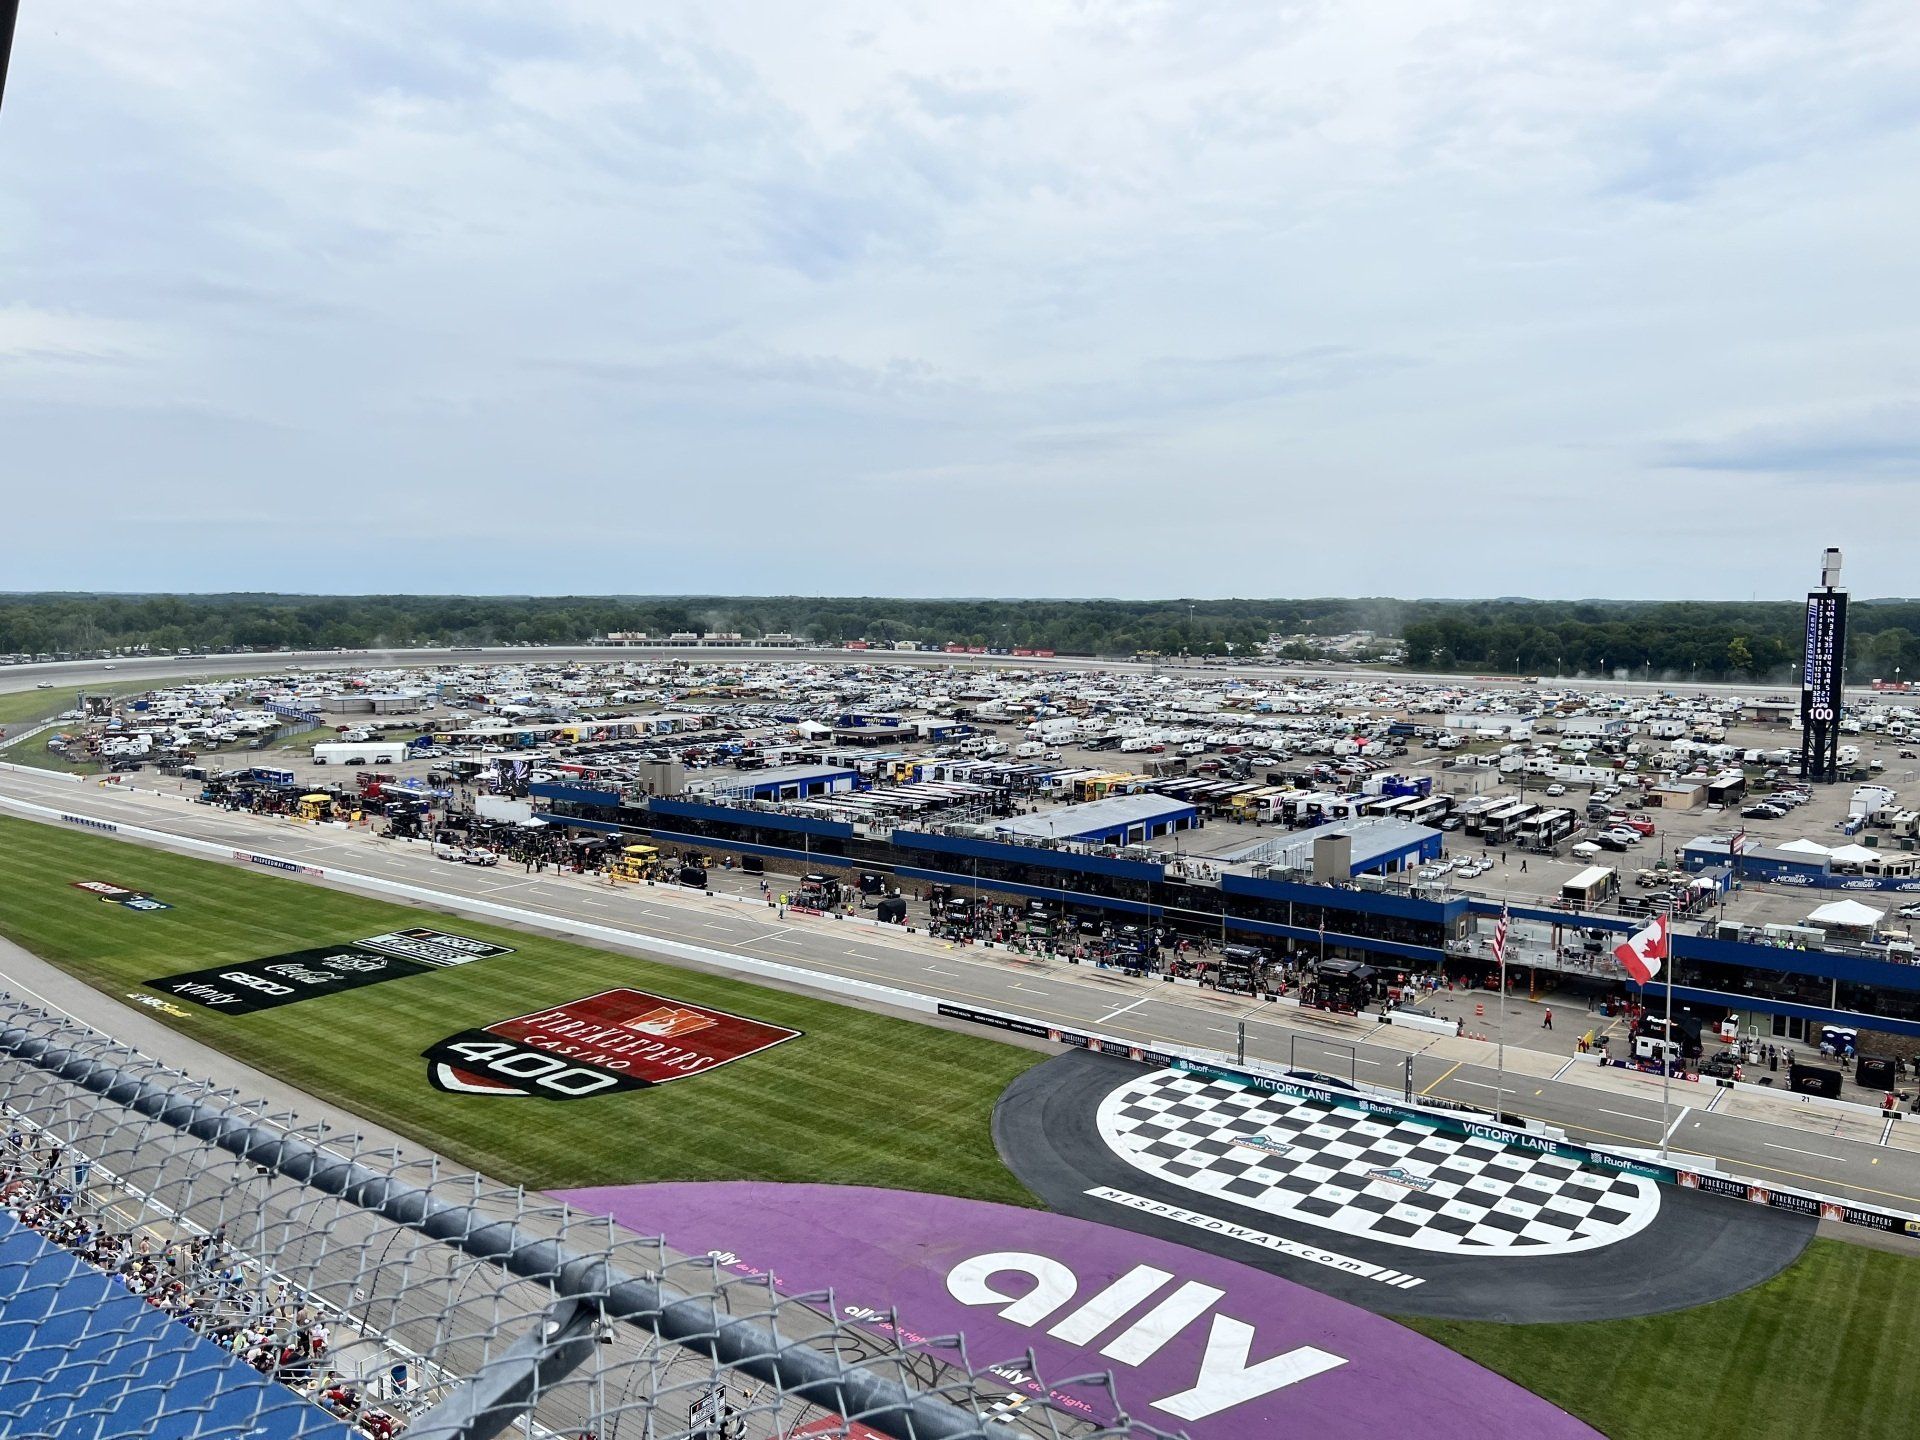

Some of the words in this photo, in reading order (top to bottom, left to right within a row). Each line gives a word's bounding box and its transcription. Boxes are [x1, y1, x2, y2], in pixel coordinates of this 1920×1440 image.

[1806, 616, 1815, 681] MISPEEDWAY.com
[1807, 708, 1834, 721] 100
[253, 855, 296, 872] MISPEEDWAY.com
[1846, 880, 1875, 888] MICHIGAN
[172, 981, 243, 1006] xfinity
[219, 971, 295, 996] GEICO
[522, 1011, 715, 1071] FIREKEEPERS
[523, 1035, 631, 1069] CASINO
[446, 1042, 619, 1096] 400
[1188, 1062, 1208, 1073] Ruoff
[1253, 1075, 1301, 1096] VICTORY
[1301, 1087, 1332, 1103] LANE
[1801, 1095, 1810, 1103] 21
[1369, 1102, 1393, 1115] Ruoff
[1462, 1121, 1519, 1145] VICTORY
[1521, 1134, 1557, 1153] LANE
[1603, 1156, 1632, 1170] Ruoff
[1701, 1176, 1745, 1195] FIREKEEPERS
[1771, 1192, 1817, 1210] FIREKEEPERS
[1846, 1209, 1893, 1227] FIREKEEPERS
[1101, 1190, 1364, 1271] MISPEEDWAY.com
[844, 1305, 884, 1323] ally
[946, 1250, 1350, 1422] ally
[1057, 1392, 1093, 1413] right.
